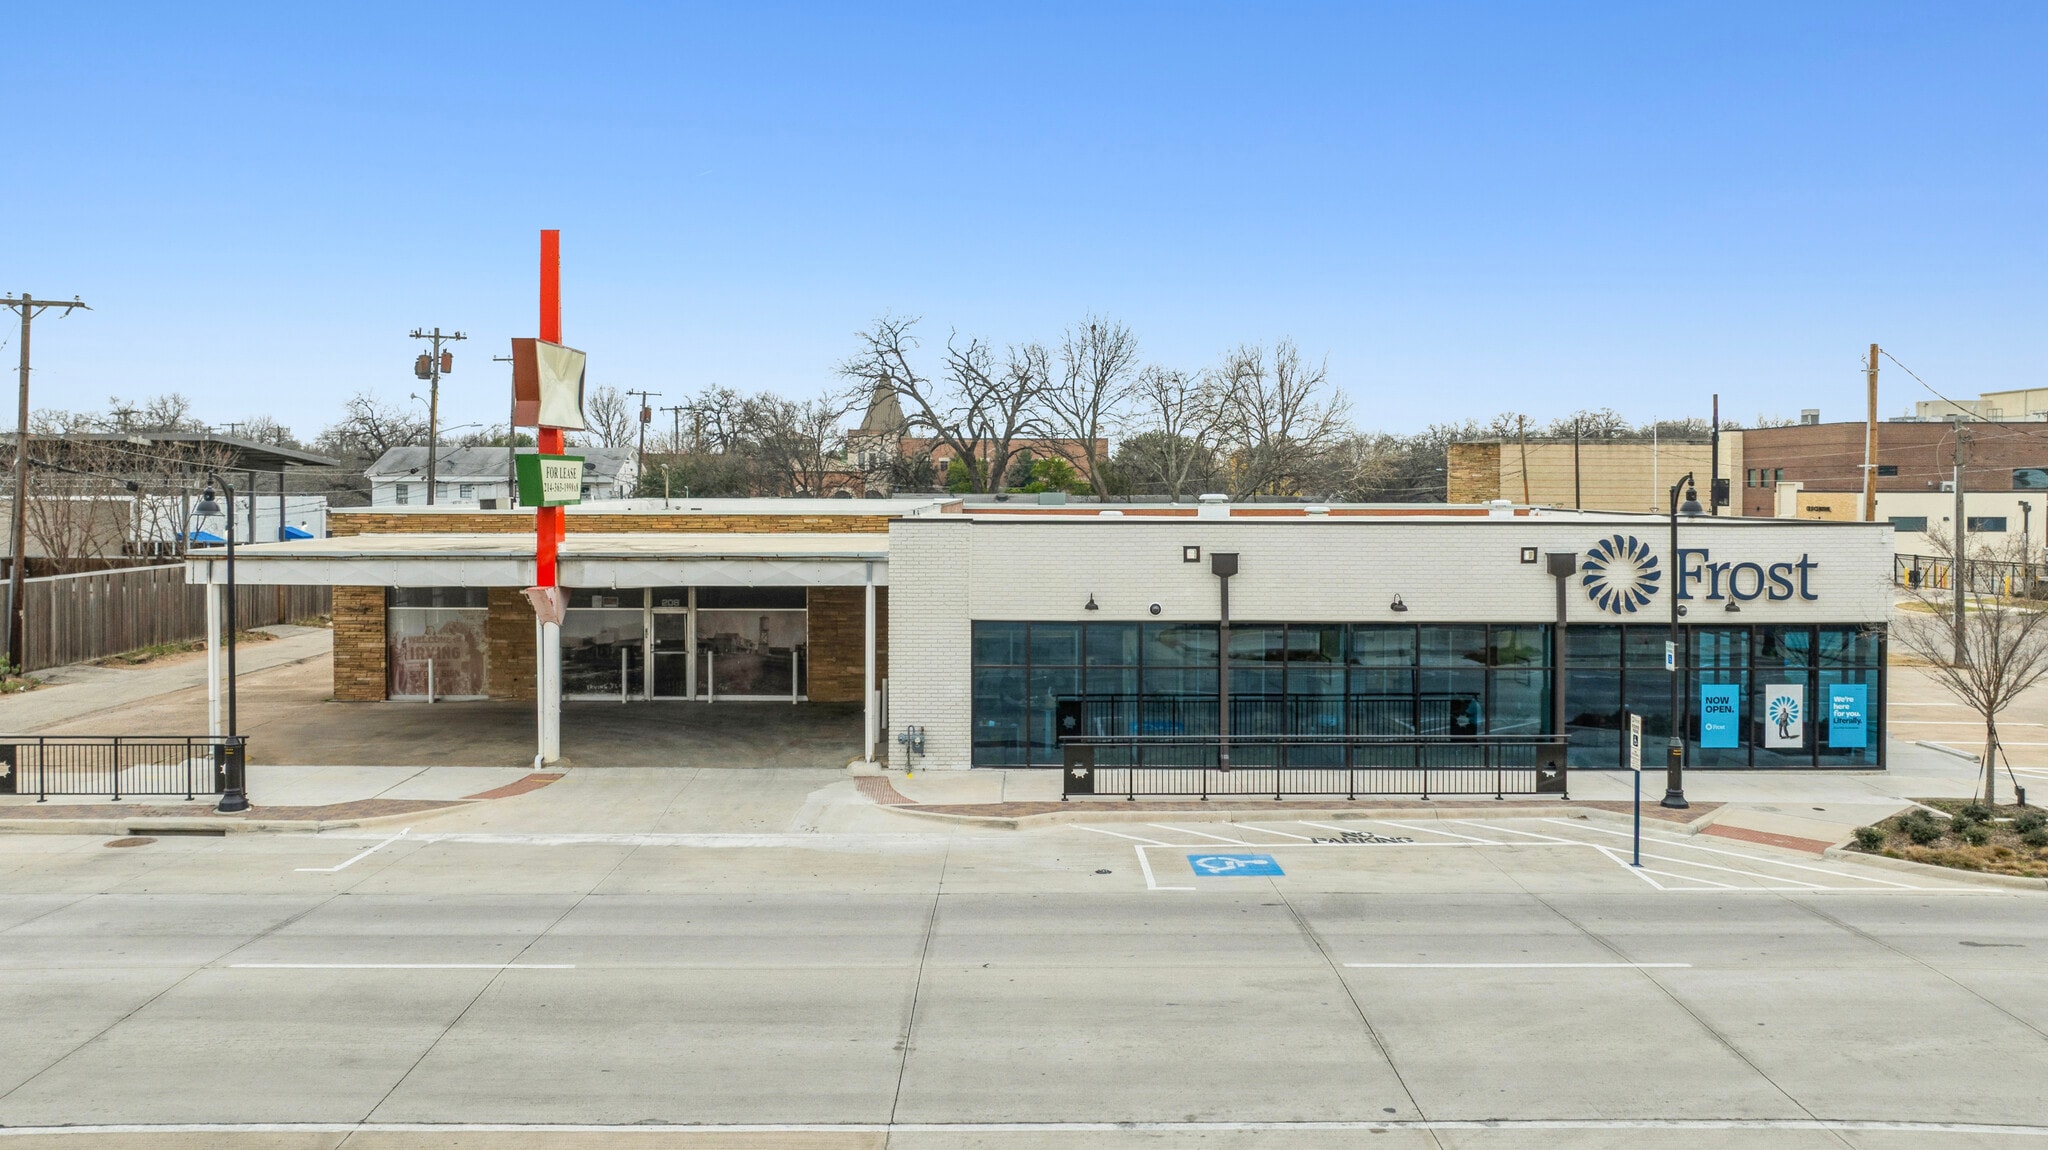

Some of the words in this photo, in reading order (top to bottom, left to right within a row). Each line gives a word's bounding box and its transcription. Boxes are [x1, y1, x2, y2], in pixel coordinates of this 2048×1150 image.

[546, 466, 558, 479] FOR
[560, 467, 577, 479] LEASE
[1677, 548, 1819, 601] Frost
[661, 599, 680, 607] 208
[410, 646, 461, 660] IRVING
[1705, 696, 1730, 704] NOW
[1833, 695, 1855, 703] We're
[1705, 705, 1735, 713] OPEN.
[1833, 709, 1845, 717] for
[1833, 717, 1863, 725] Literally.
